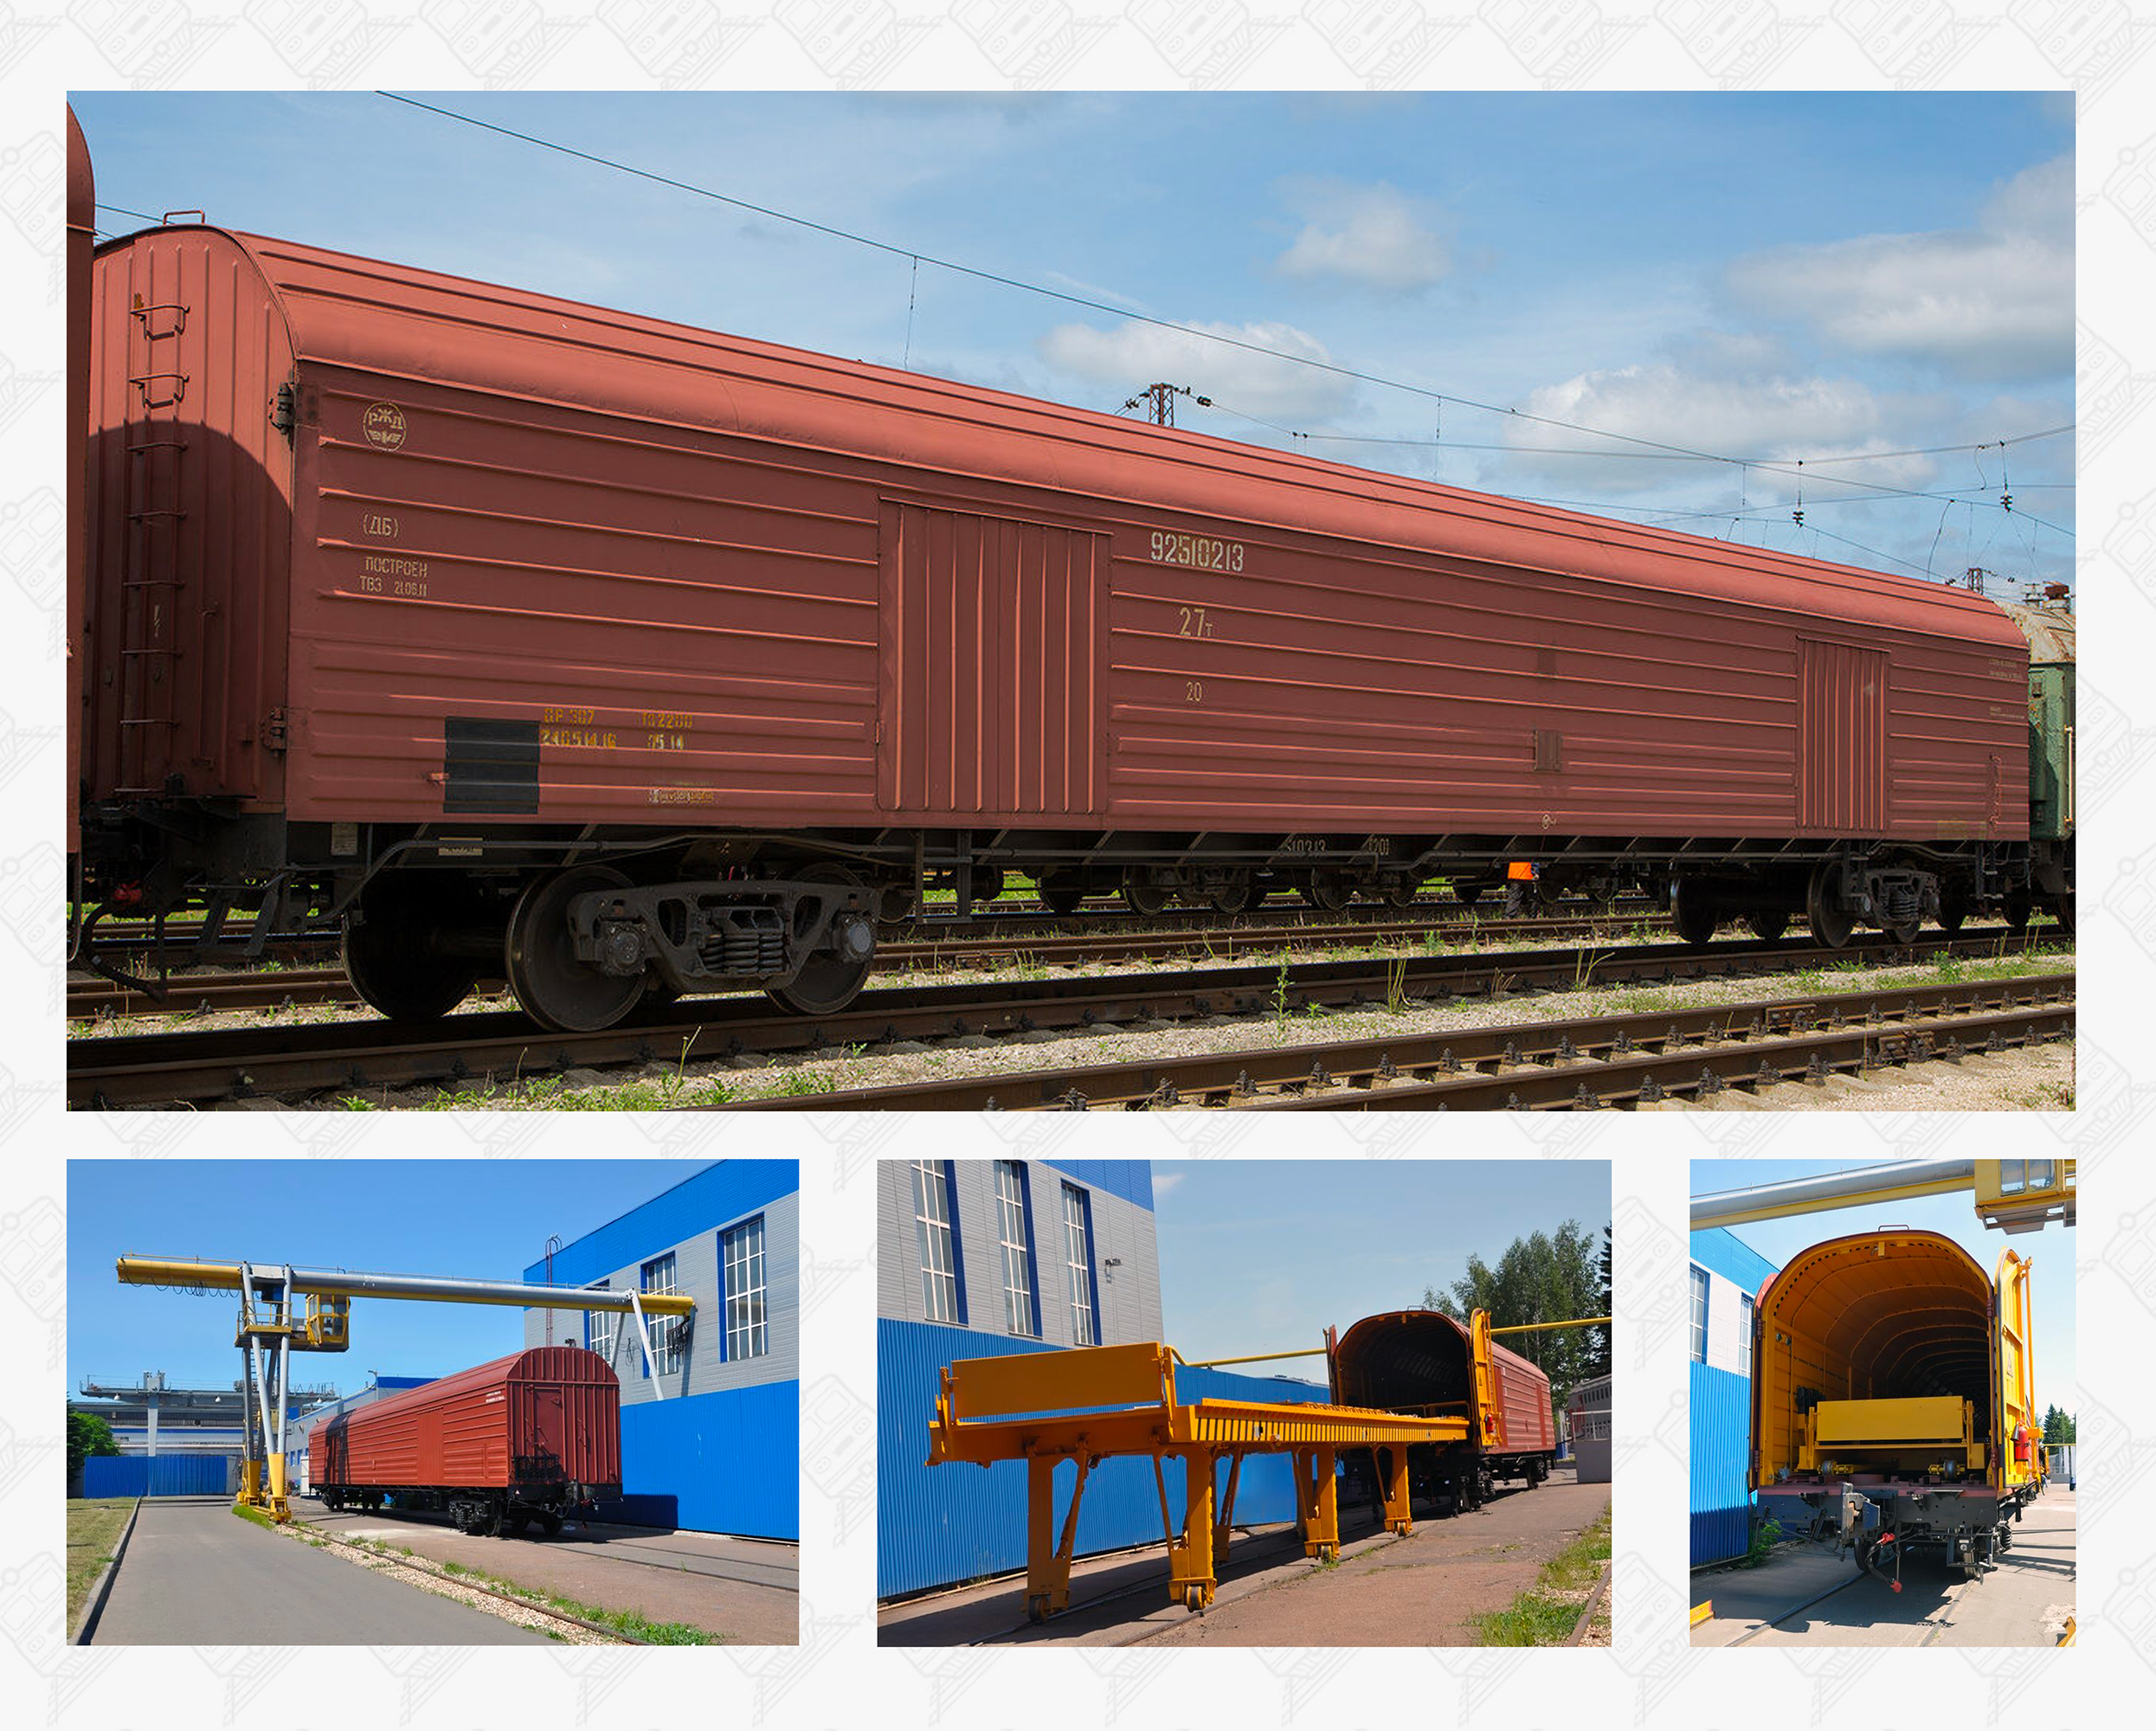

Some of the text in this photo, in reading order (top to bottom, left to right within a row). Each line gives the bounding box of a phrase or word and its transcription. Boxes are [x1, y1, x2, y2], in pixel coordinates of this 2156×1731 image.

[364, 514, 399, 537] (ДБ)
[1150, 531, 1245, 572] 92510213
[365, 556, 428, 578] ПОСТРОЕН
[359, 575, 383, 593] ТВЗ
[1185, 681, 1203, 703] 20
